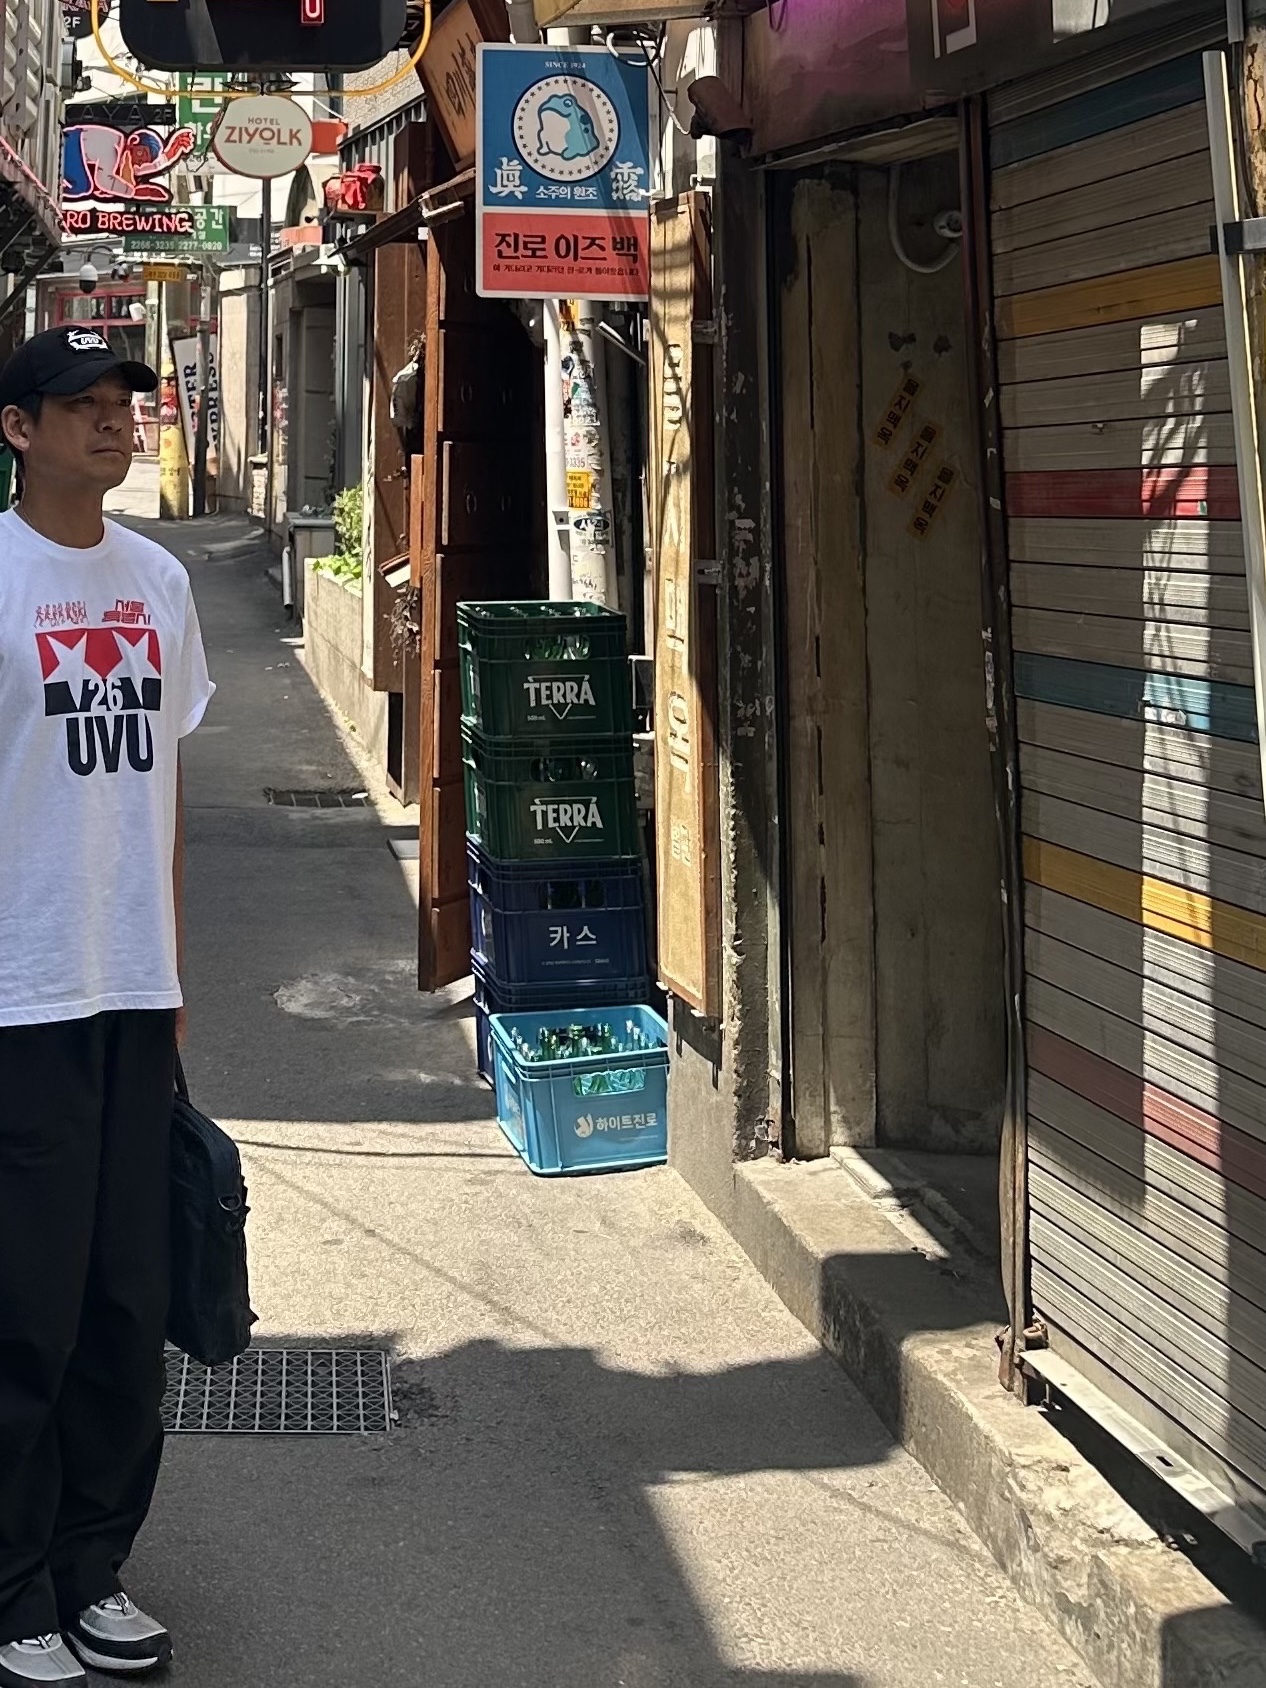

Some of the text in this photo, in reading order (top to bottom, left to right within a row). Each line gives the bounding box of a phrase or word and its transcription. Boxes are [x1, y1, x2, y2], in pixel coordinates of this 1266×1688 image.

[64, 16, 81, 28] 2F
[545, 61, 568, 69] SINCE
[67, 104, 173, 126] AYA 2F
[248, 117, 280, 126] HOTEL
[224, 126, 302, 147] ZIYOLK
[535, 185, 598, 200] 소주의 원조
[63, 210, 194, 234] RO BREWING
[494, 232, 639, 264] 진로 이즈 백
[87, 678, 124, 713] 26
[523, 680, 596, 707] TERRA
[66, 713, 153, 776] UVU
[530, 802, 603, 830] TERRA
[549, 925, 597, 950] 카스
[595, 1112, 658, 1132] 하이트진로
